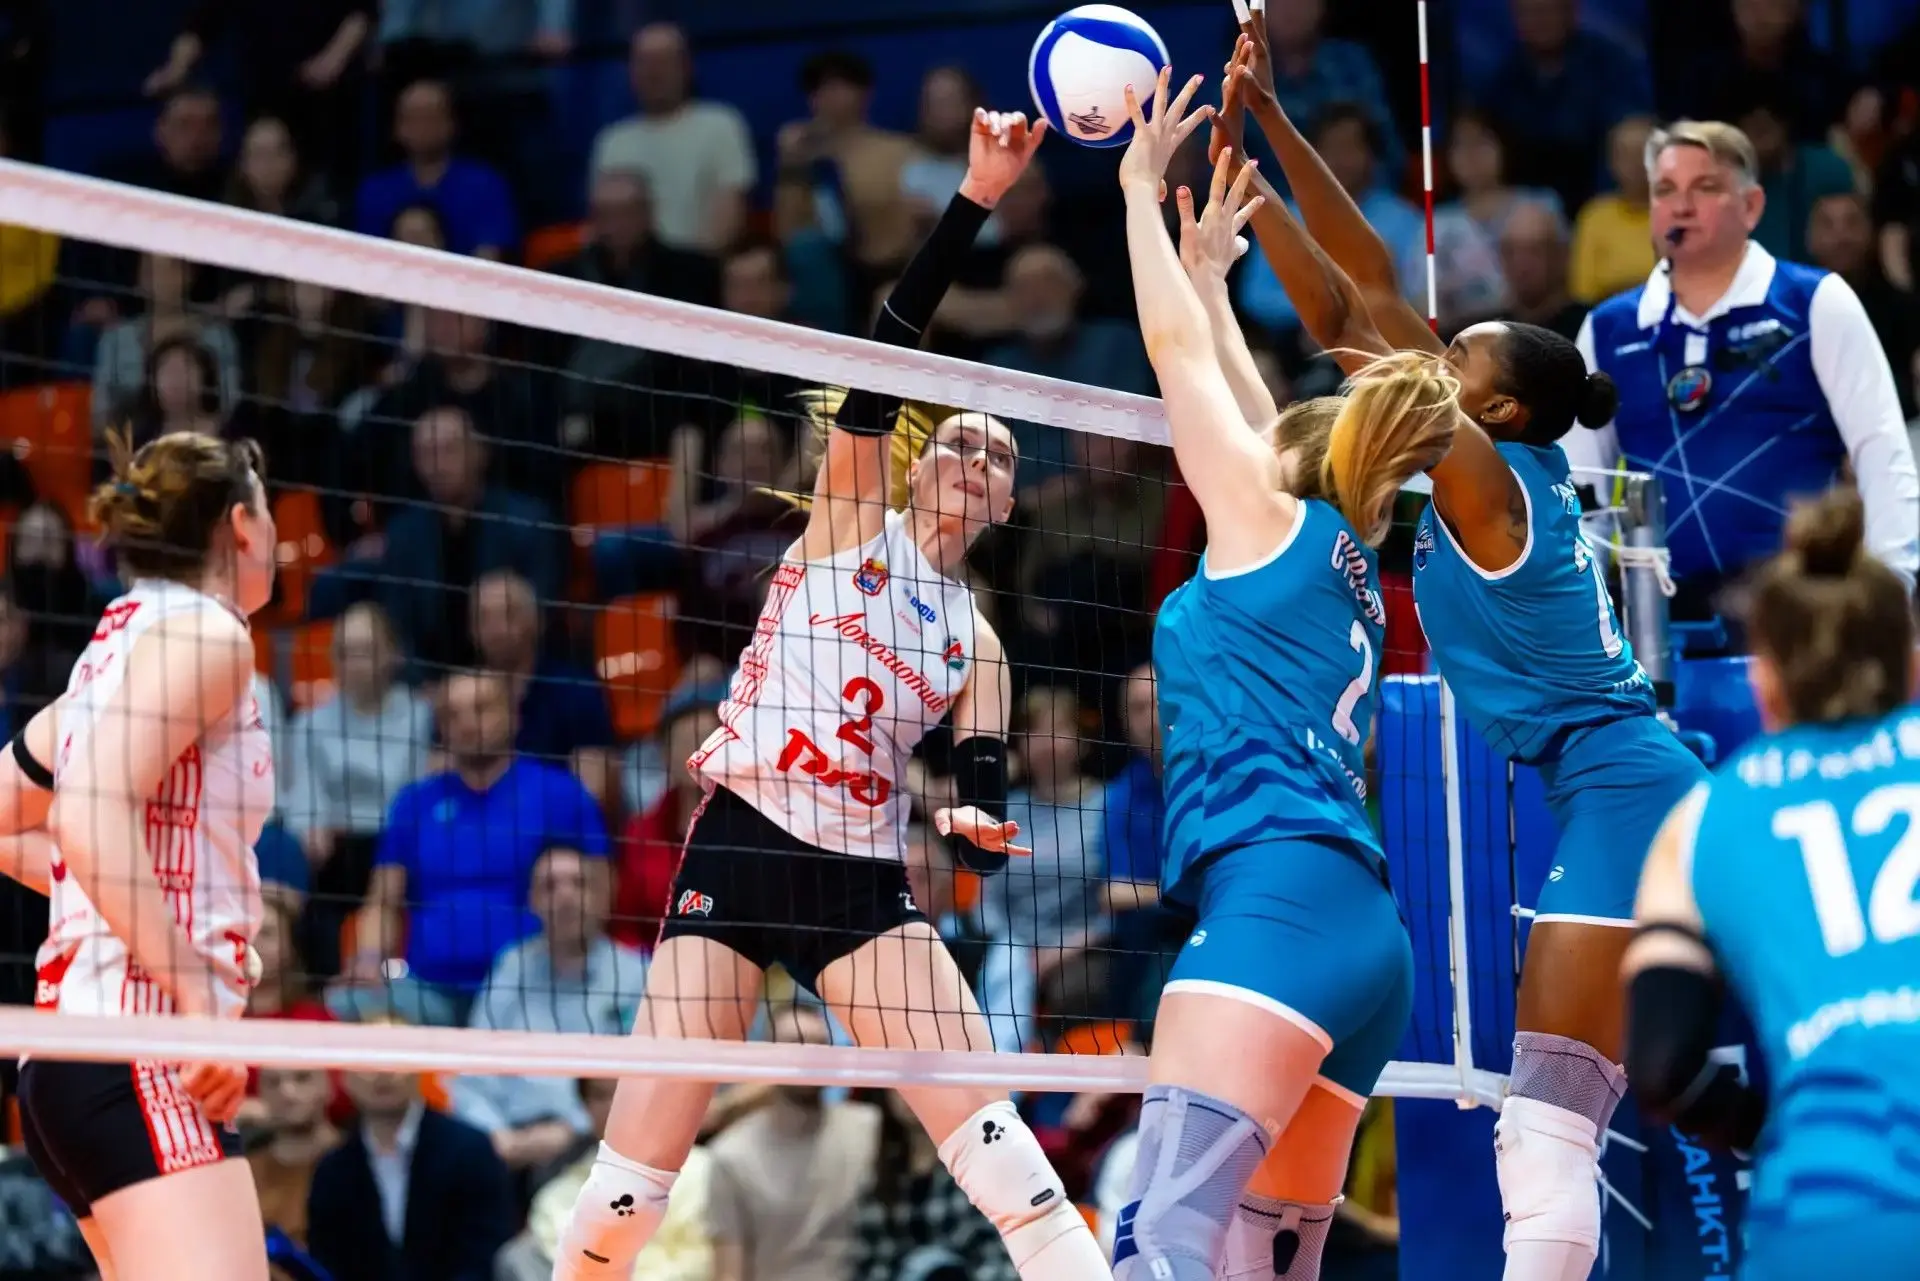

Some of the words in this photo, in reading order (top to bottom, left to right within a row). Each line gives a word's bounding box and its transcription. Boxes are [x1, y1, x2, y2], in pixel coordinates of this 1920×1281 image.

[836, 677, 884, 756] 2
[1331, 619, 1374, 746] 2
[1771, 782, 1920, 958] 12
